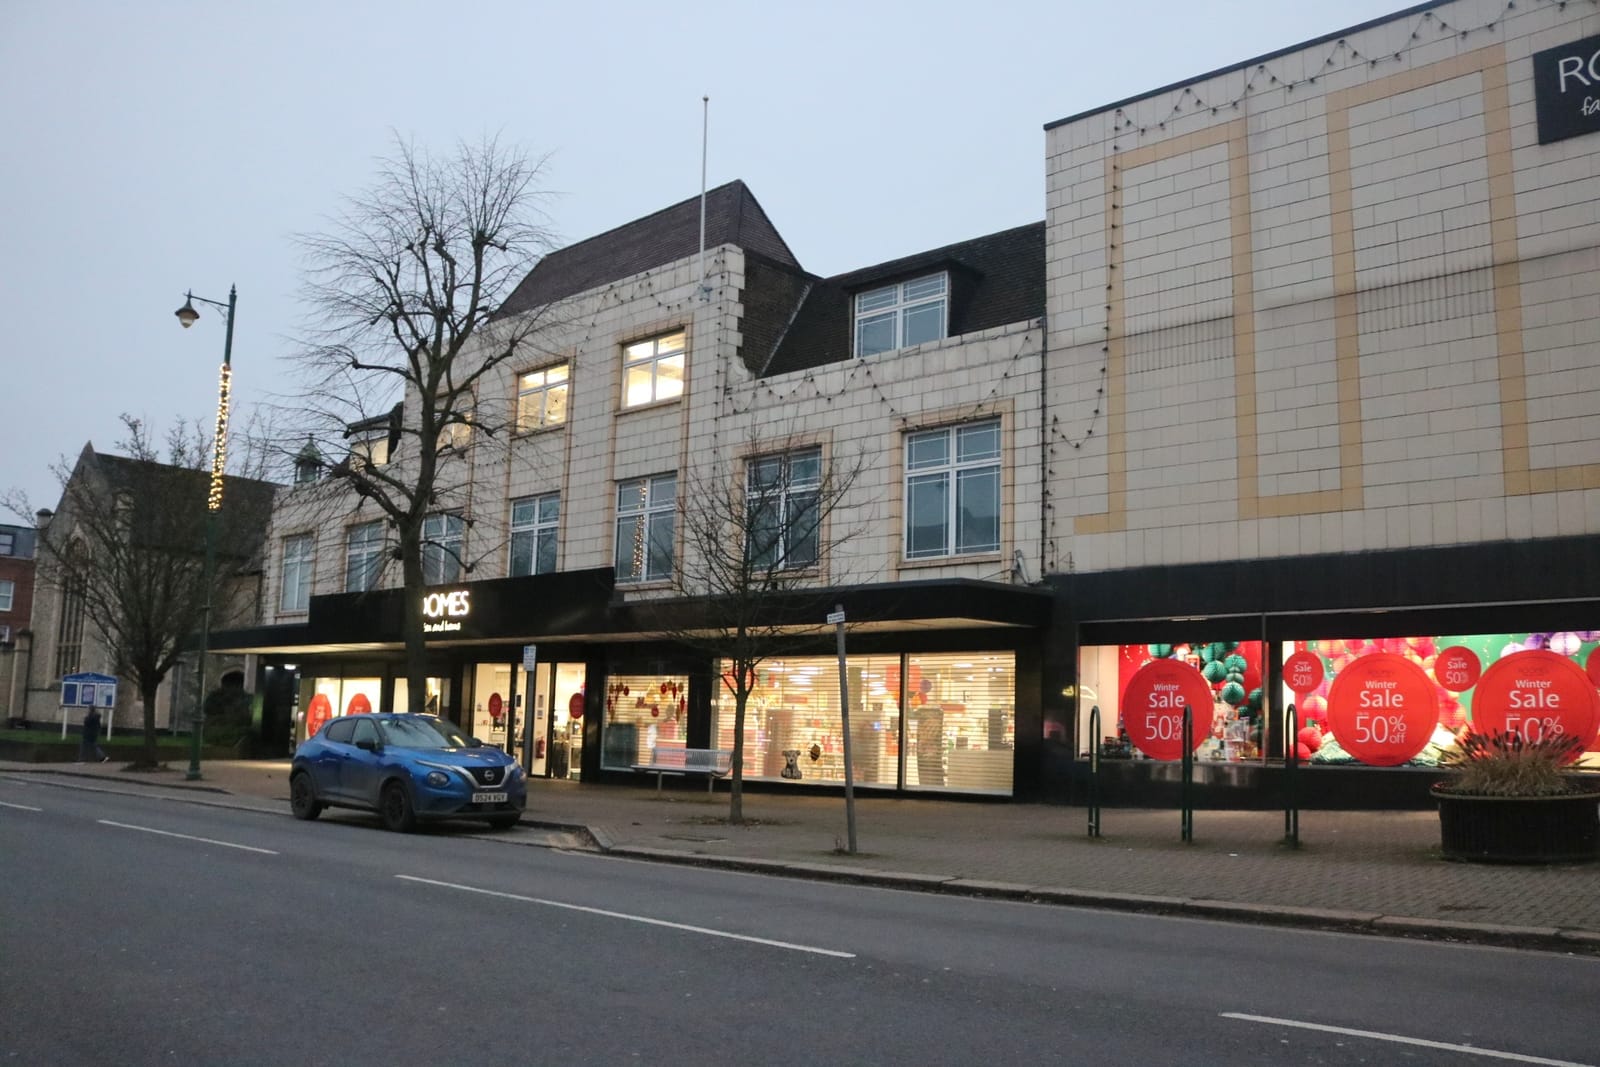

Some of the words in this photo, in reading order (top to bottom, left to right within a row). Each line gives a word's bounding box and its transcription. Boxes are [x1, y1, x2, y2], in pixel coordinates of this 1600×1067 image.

[1447, 660, 1467, 669] Sale
[1153, 683, 1180, 691] Winter
[1365, 680, 1397, 689] Winter
[1515, 679, 1552, 689] Winter
[1148, 691, 1185, 708] Sale
[1359, 689, 1404, 707] Sale
[1509, 689, 1560, 708] Sale
[1355, 714, 1407, 743] 50%
[1390, 732, 1406, 744] off
